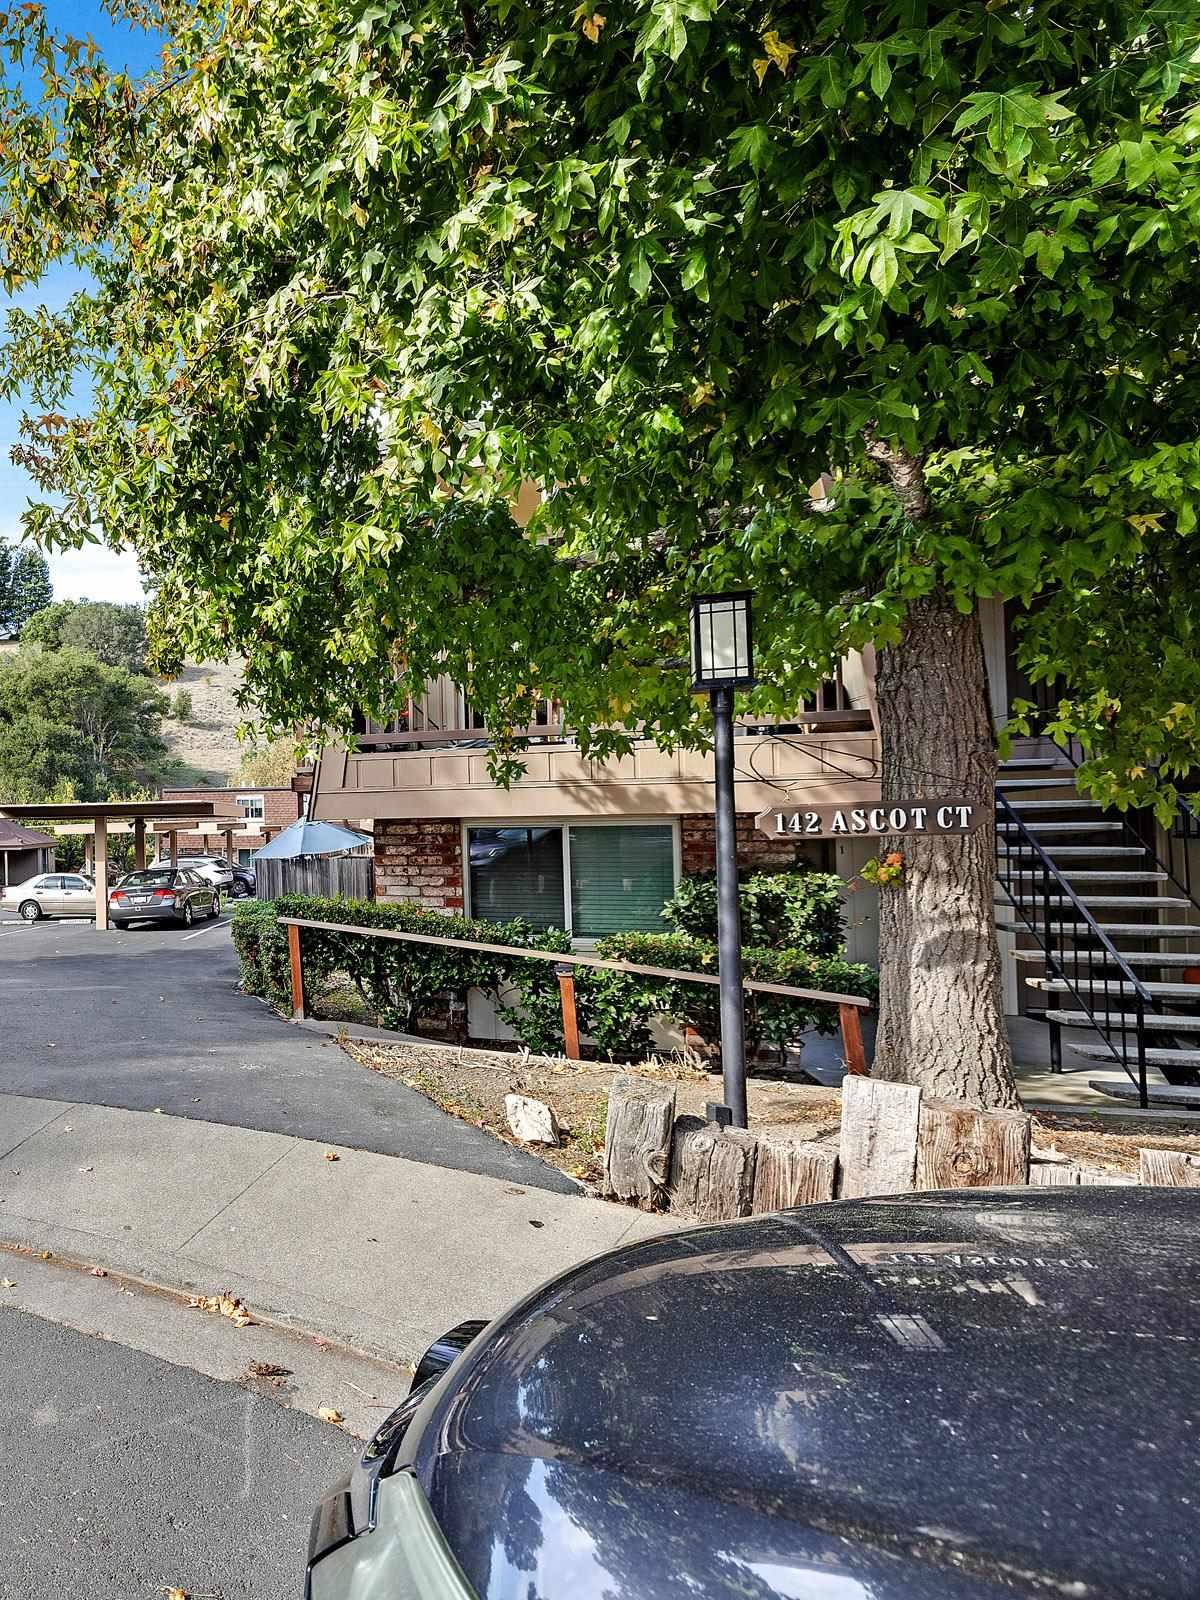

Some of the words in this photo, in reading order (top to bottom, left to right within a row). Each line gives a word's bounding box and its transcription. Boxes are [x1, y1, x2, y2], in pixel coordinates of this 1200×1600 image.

[774, 812, 819, 833] 142
[831, 807, 927, 832] ASCOT
[937, 806, 972, 829] CT
